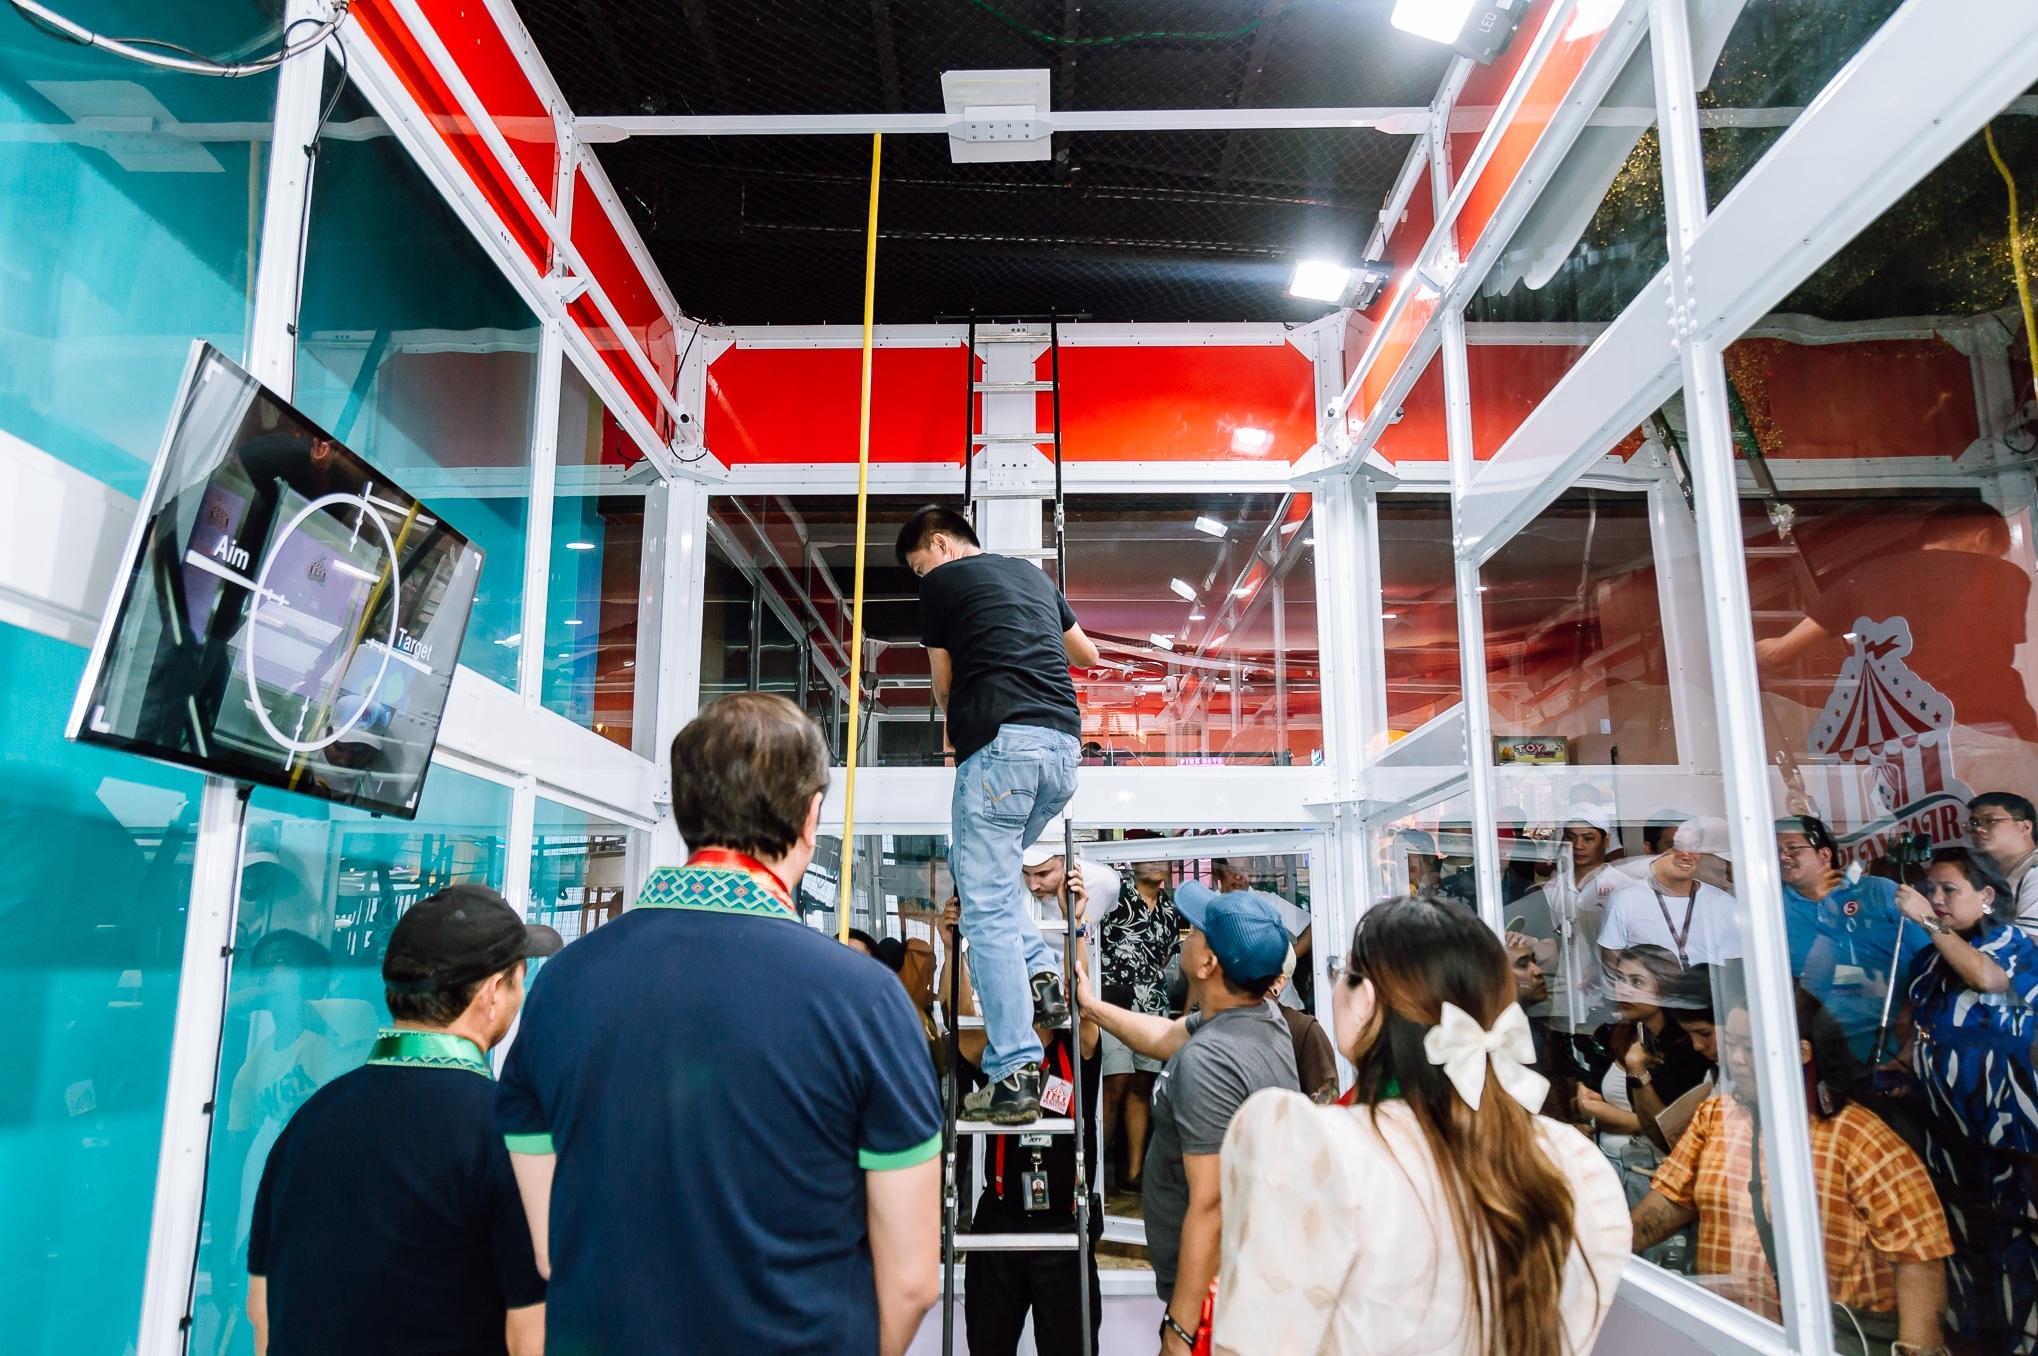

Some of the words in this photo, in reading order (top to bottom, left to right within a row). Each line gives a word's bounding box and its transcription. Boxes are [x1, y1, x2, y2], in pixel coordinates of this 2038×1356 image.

[1478, 12, 1497, 33] LED
[213, 534, 250, 571] Aim
[397, 627, 433, 661] Target
[1514, 743, 1545, 755] TOY
